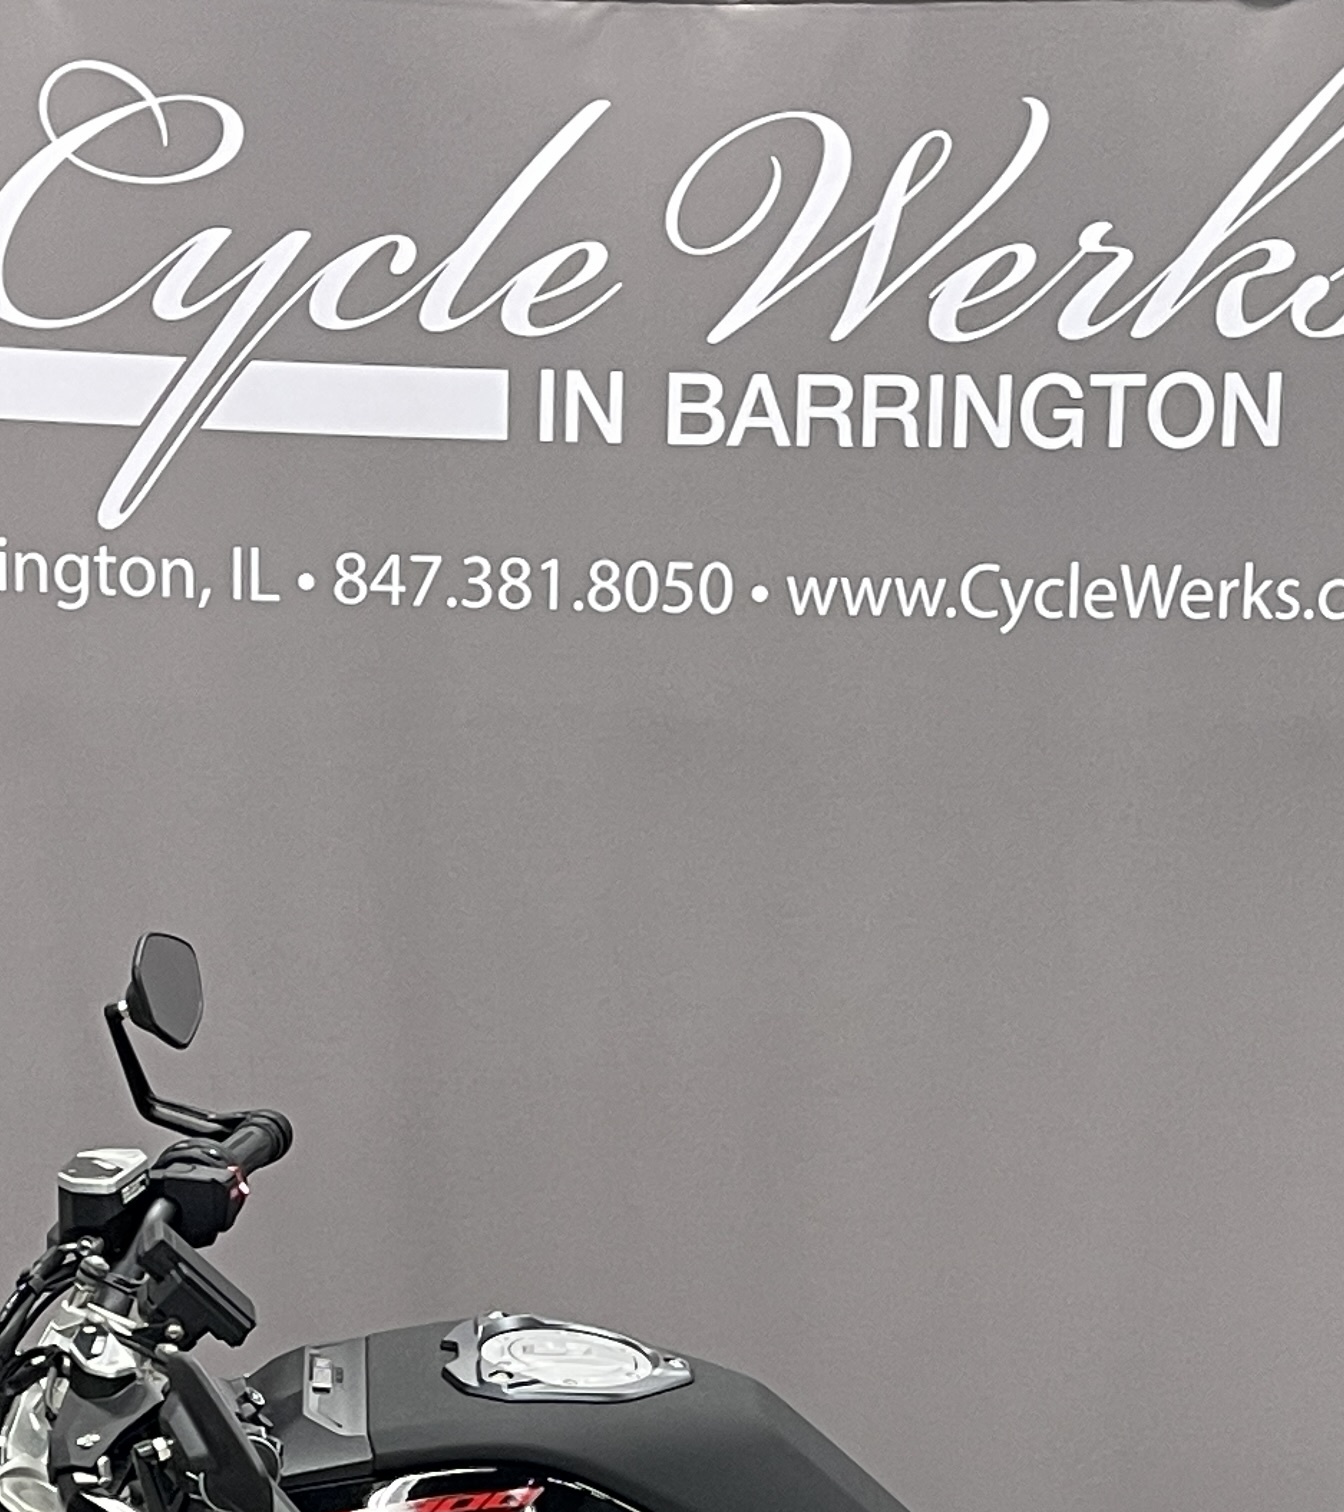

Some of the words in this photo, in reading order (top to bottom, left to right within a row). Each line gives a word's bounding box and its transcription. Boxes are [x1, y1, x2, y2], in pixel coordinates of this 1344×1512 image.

[538, 368, 625, 445] IN
[666, 370, 1283, 451] BARRINGTON
[231, 545, 281, 603] IL
[332, 551, 734, 616] 847.381.8050
